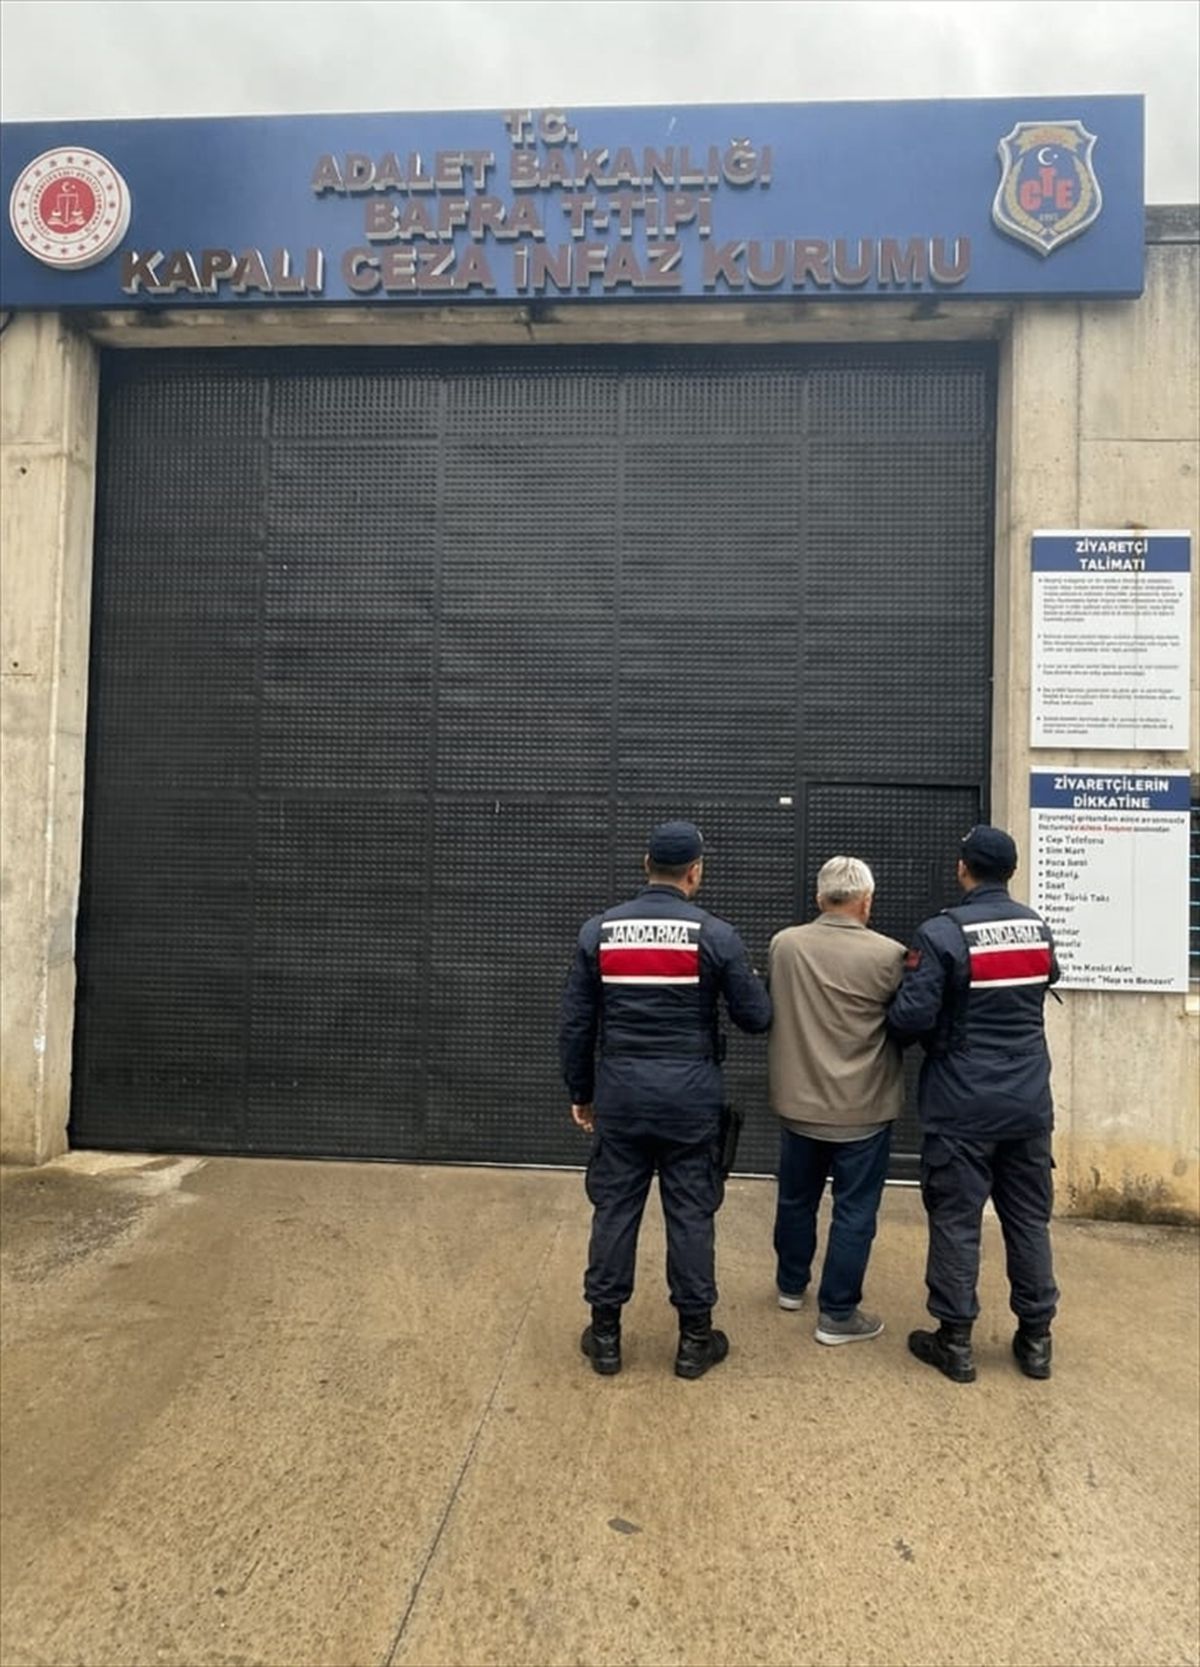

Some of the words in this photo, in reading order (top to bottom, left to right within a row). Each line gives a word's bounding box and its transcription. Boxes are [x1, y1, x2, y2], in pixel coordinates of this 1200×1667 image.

[504, 109, 578, 146] T.C.
[312, 151, 495, 193] ADALET
[509, 137, 773, 189] BAKANLIĞI
[365, 194, 545, 240] BAFRA
[121, 247, 325, 294] KAPALI
[341, 244, 496, 292] CEZA
[702, 236, 972, 289] KURUMU
[1075, 538, 1149, 555] ZİYARETÇİ
[1079, 556, 1146, 571] TALİMATI
[1073, 794, 1151, 809] DİKKATİNE
[607, 925, 690, 944] JANDARMA
[974, 925, 1043, 946] JANDARMA
